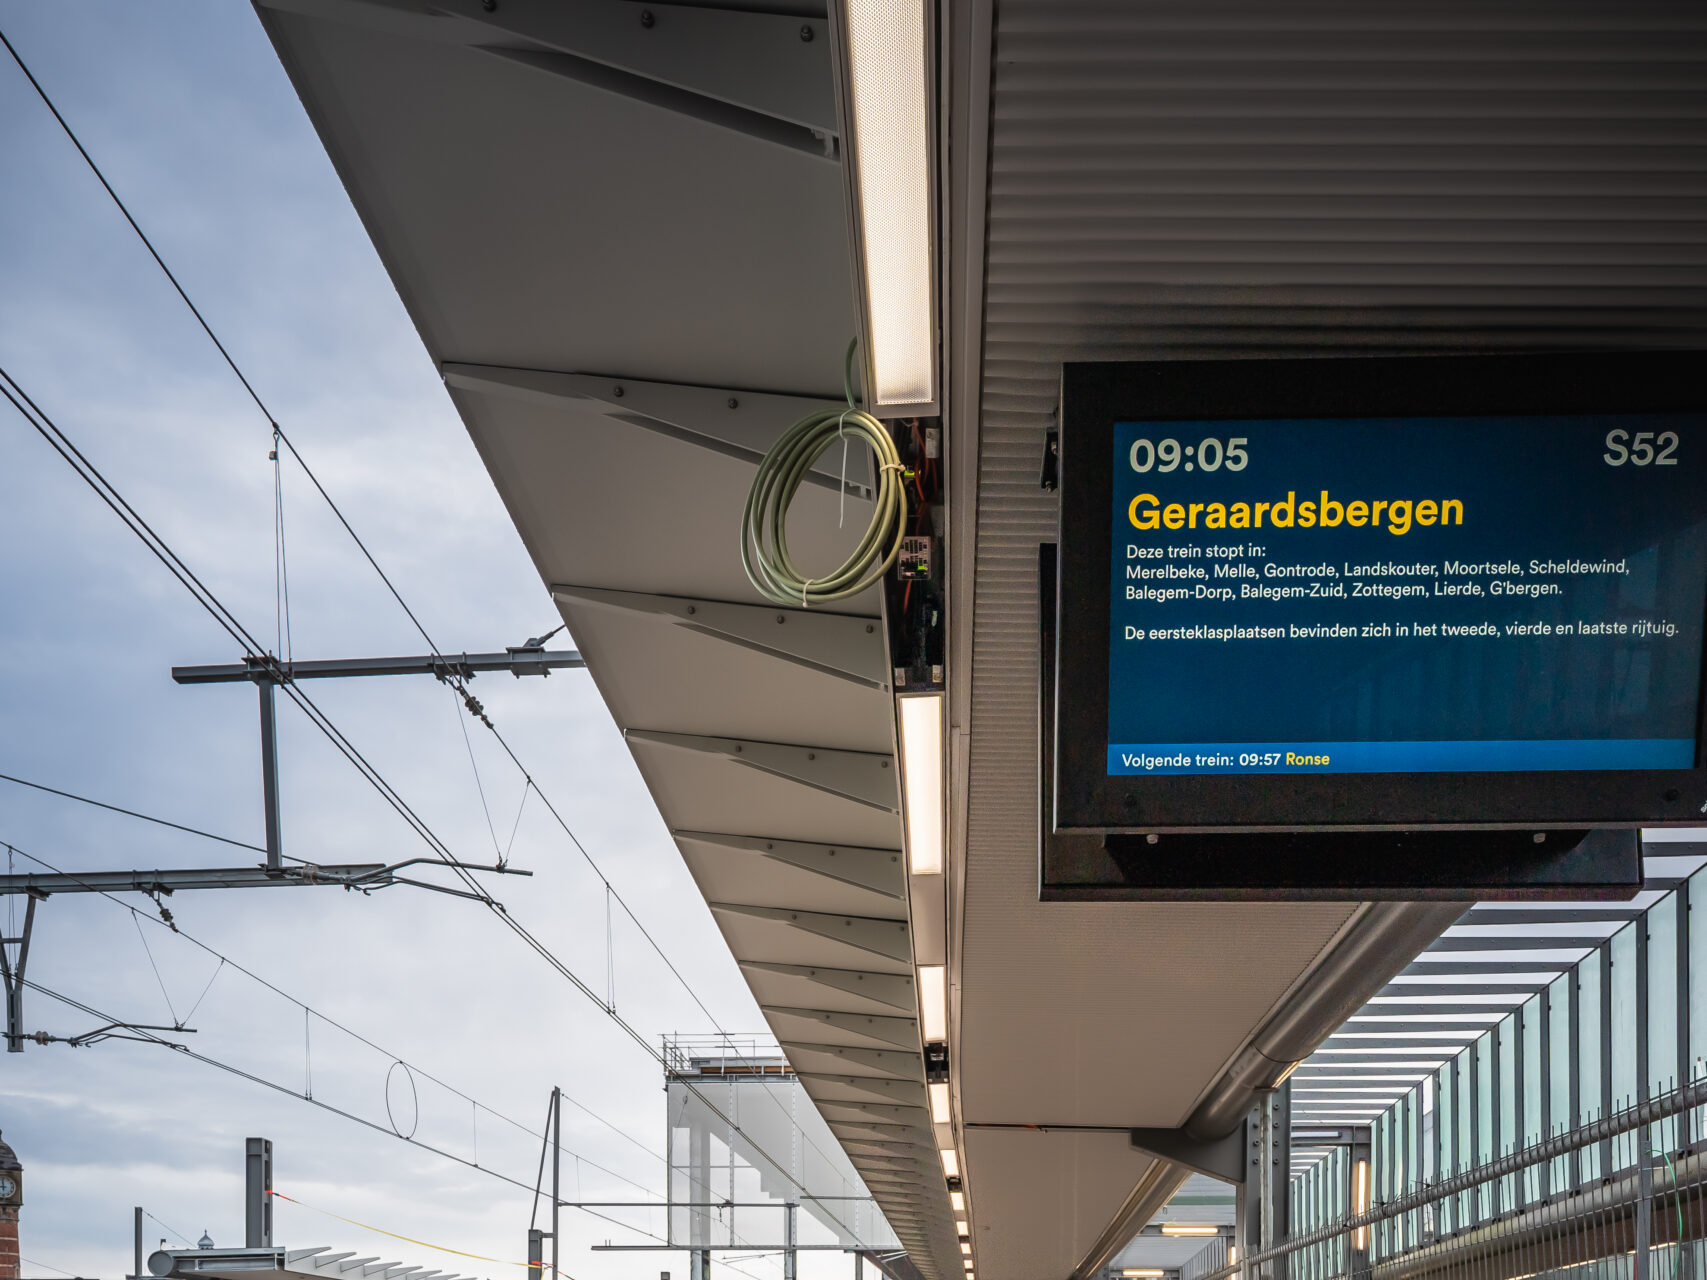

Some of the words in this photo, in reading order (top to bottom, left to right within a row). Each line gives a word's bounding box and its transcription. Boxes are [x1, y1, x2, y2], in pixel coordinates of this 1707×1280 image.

[1129, 437, 1249, 473] 09:05
[1603, 428, 1680, 466] S52
[1128, 490, 1464, 536] Geraardsbergen
[1126, 544, 1164, 559] Deze
[1167, 543, 1202, 559] trein
[1205, 544, 1245, 561] stopt
[1248, 542, 1266, 557] in:
[1126, 563, 1209, 581] Merelbeke,
[1214, 563, 1260, 580] Melle,
[1264, 561, 1340, 579] Gontrode,
[1344, 561, 1439, 578] Landskouter,
[1443, 559, 1525, 577] Moortsele,
[1529, 558, 1630, 576] Scheldewind,
[1125, 584, 1237, 603] Balegem-Dorp,
[1240, 582, 1348, 602] Balegem-Zuid,
[1351, 582, 1430, 600] Zottegem,
[1434, 580, 1485, 598] Lierde,
[1489, 580, 1563, 598] G'bergen.
[1124, 625, 1146, 640] De
[1148, 624, 1286, 642] eersteklasplaatsen
[1289, 622, 1358, 639] bevinden
[1361, 622, 1392, 638] zich
[1395, 622, 1409, 637] in
[1413, 621, 1438, 637] het
[1440, 621, 1501, 638] tweede,
[1505, 620, 1552, 636] vierde
[1555, 624, 1574, 635] en
[1578, 620, 1628, 635] laatste
[1632, 619, 1679, 638] rijtuig.
[1121, 752, 1192, 770] Volgende
[1195, 752, 1234, 767] trein:
[1239, 753, 1282, 766] 09:57
[1286, 752, 1330, 766] Ronse
